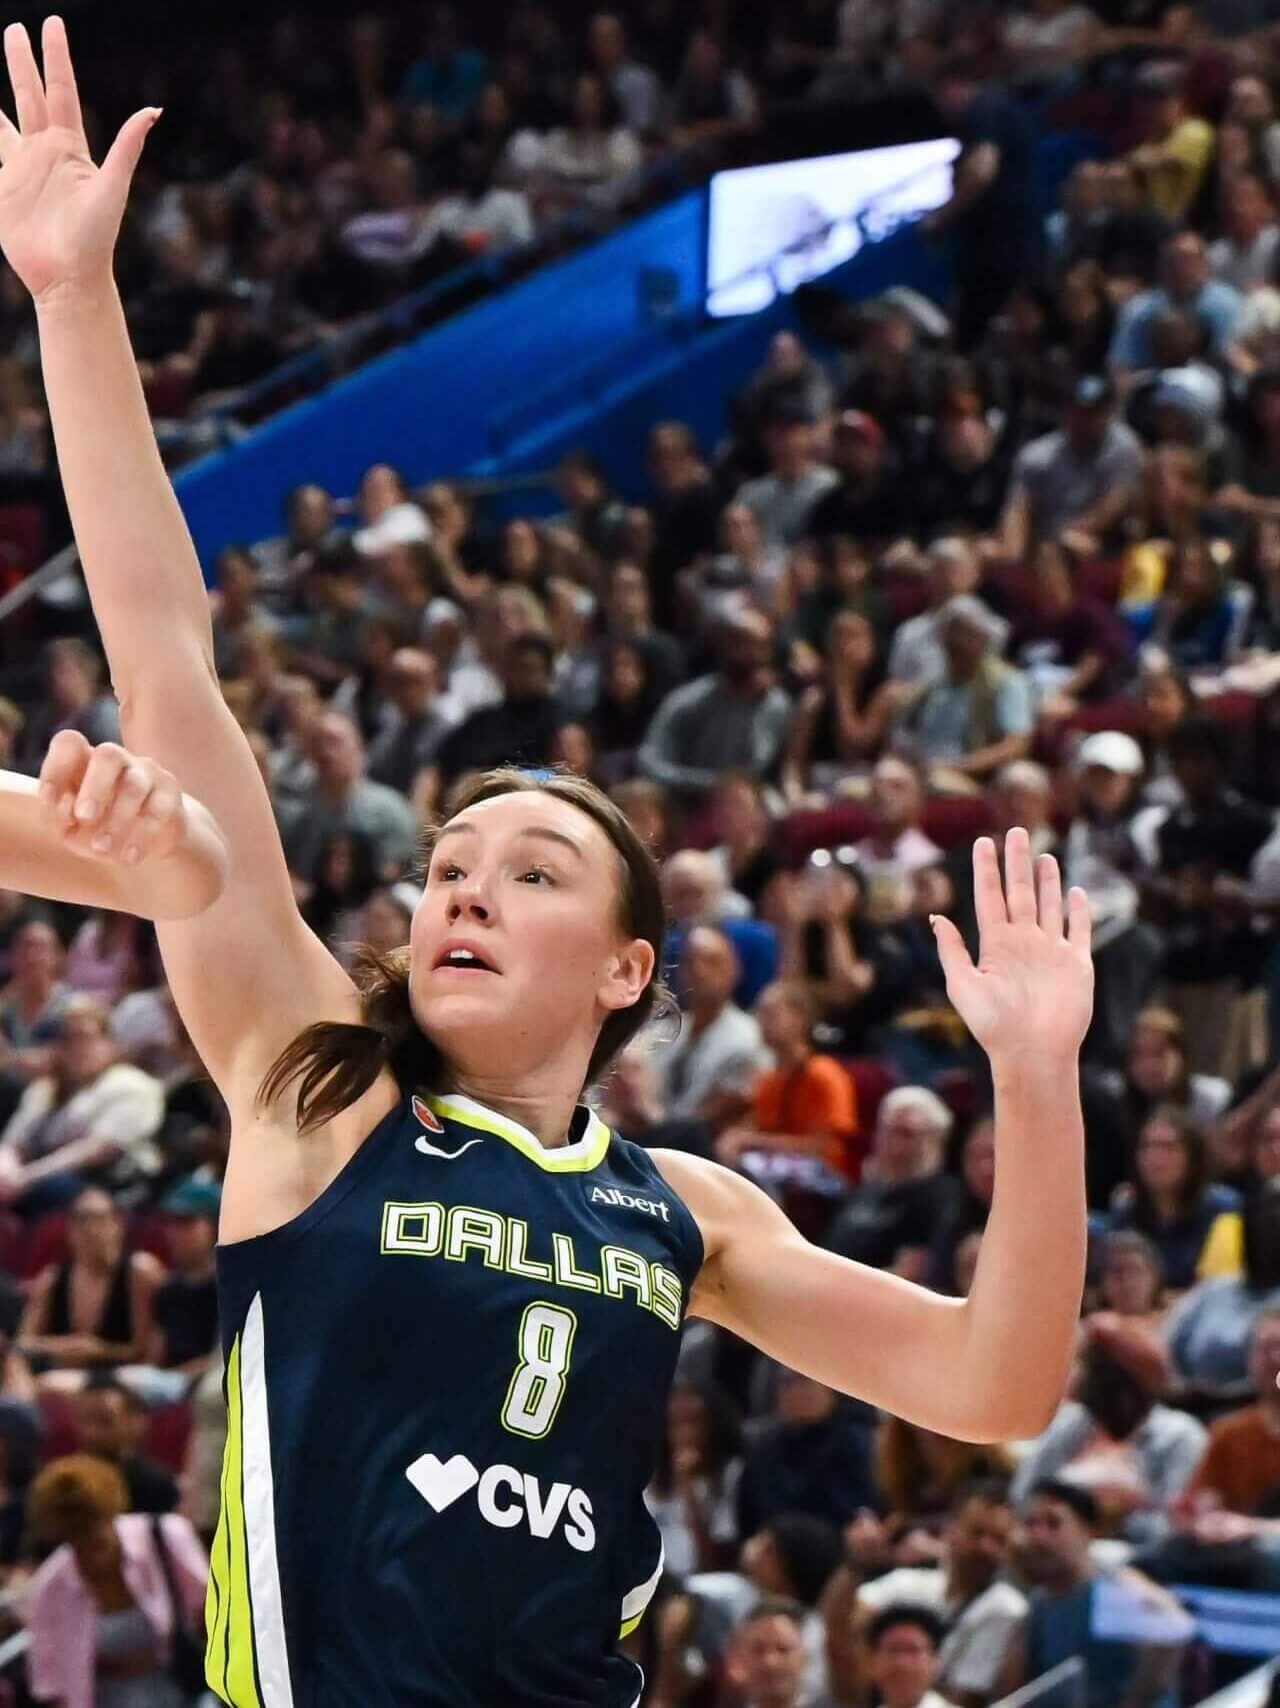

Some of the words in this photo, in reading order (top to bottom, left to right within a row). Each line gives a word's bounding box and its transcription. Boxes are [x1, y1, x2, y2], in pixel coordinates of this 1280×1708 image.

[590, 1186, 670, 1223] Albert
[380, 1202, 682, 1331] DALLAS
[501, 1300, 578, 1440] 8
[477, 1464, 596, 1553] CVS
